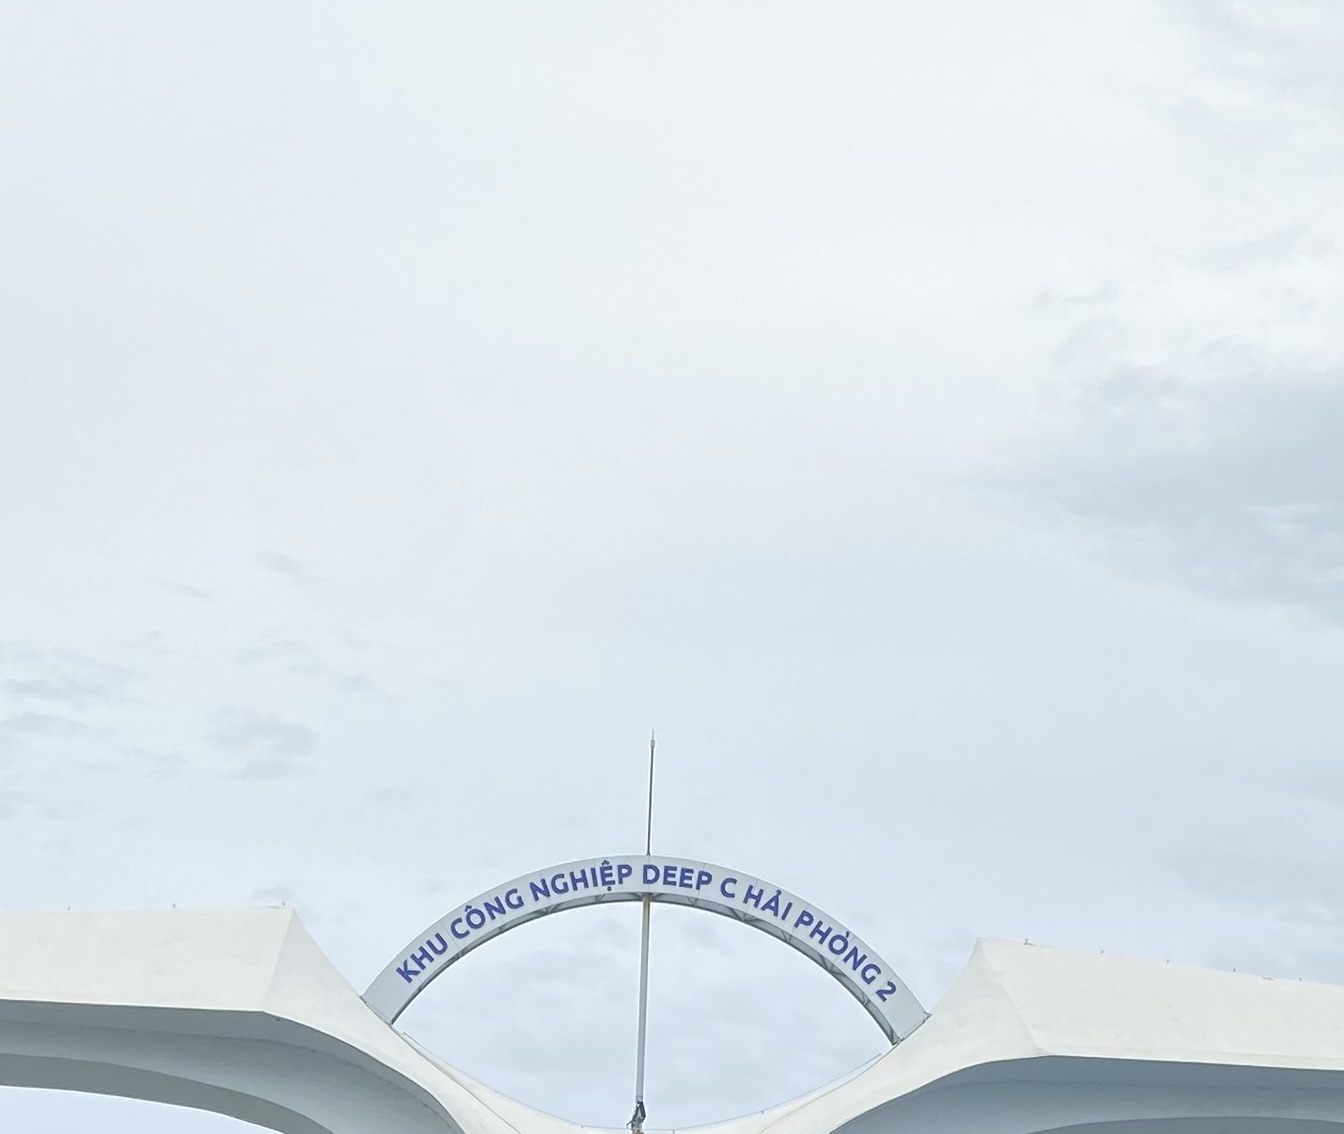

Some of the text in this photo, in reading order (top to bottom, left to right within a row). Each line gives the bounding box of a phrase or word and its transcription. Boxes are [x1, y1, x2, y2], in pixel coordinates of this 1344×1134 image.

[396, 859, 897, 1002] KHU CÔNG NGHIỆP DEEP C HẢI PHÒNG 2
